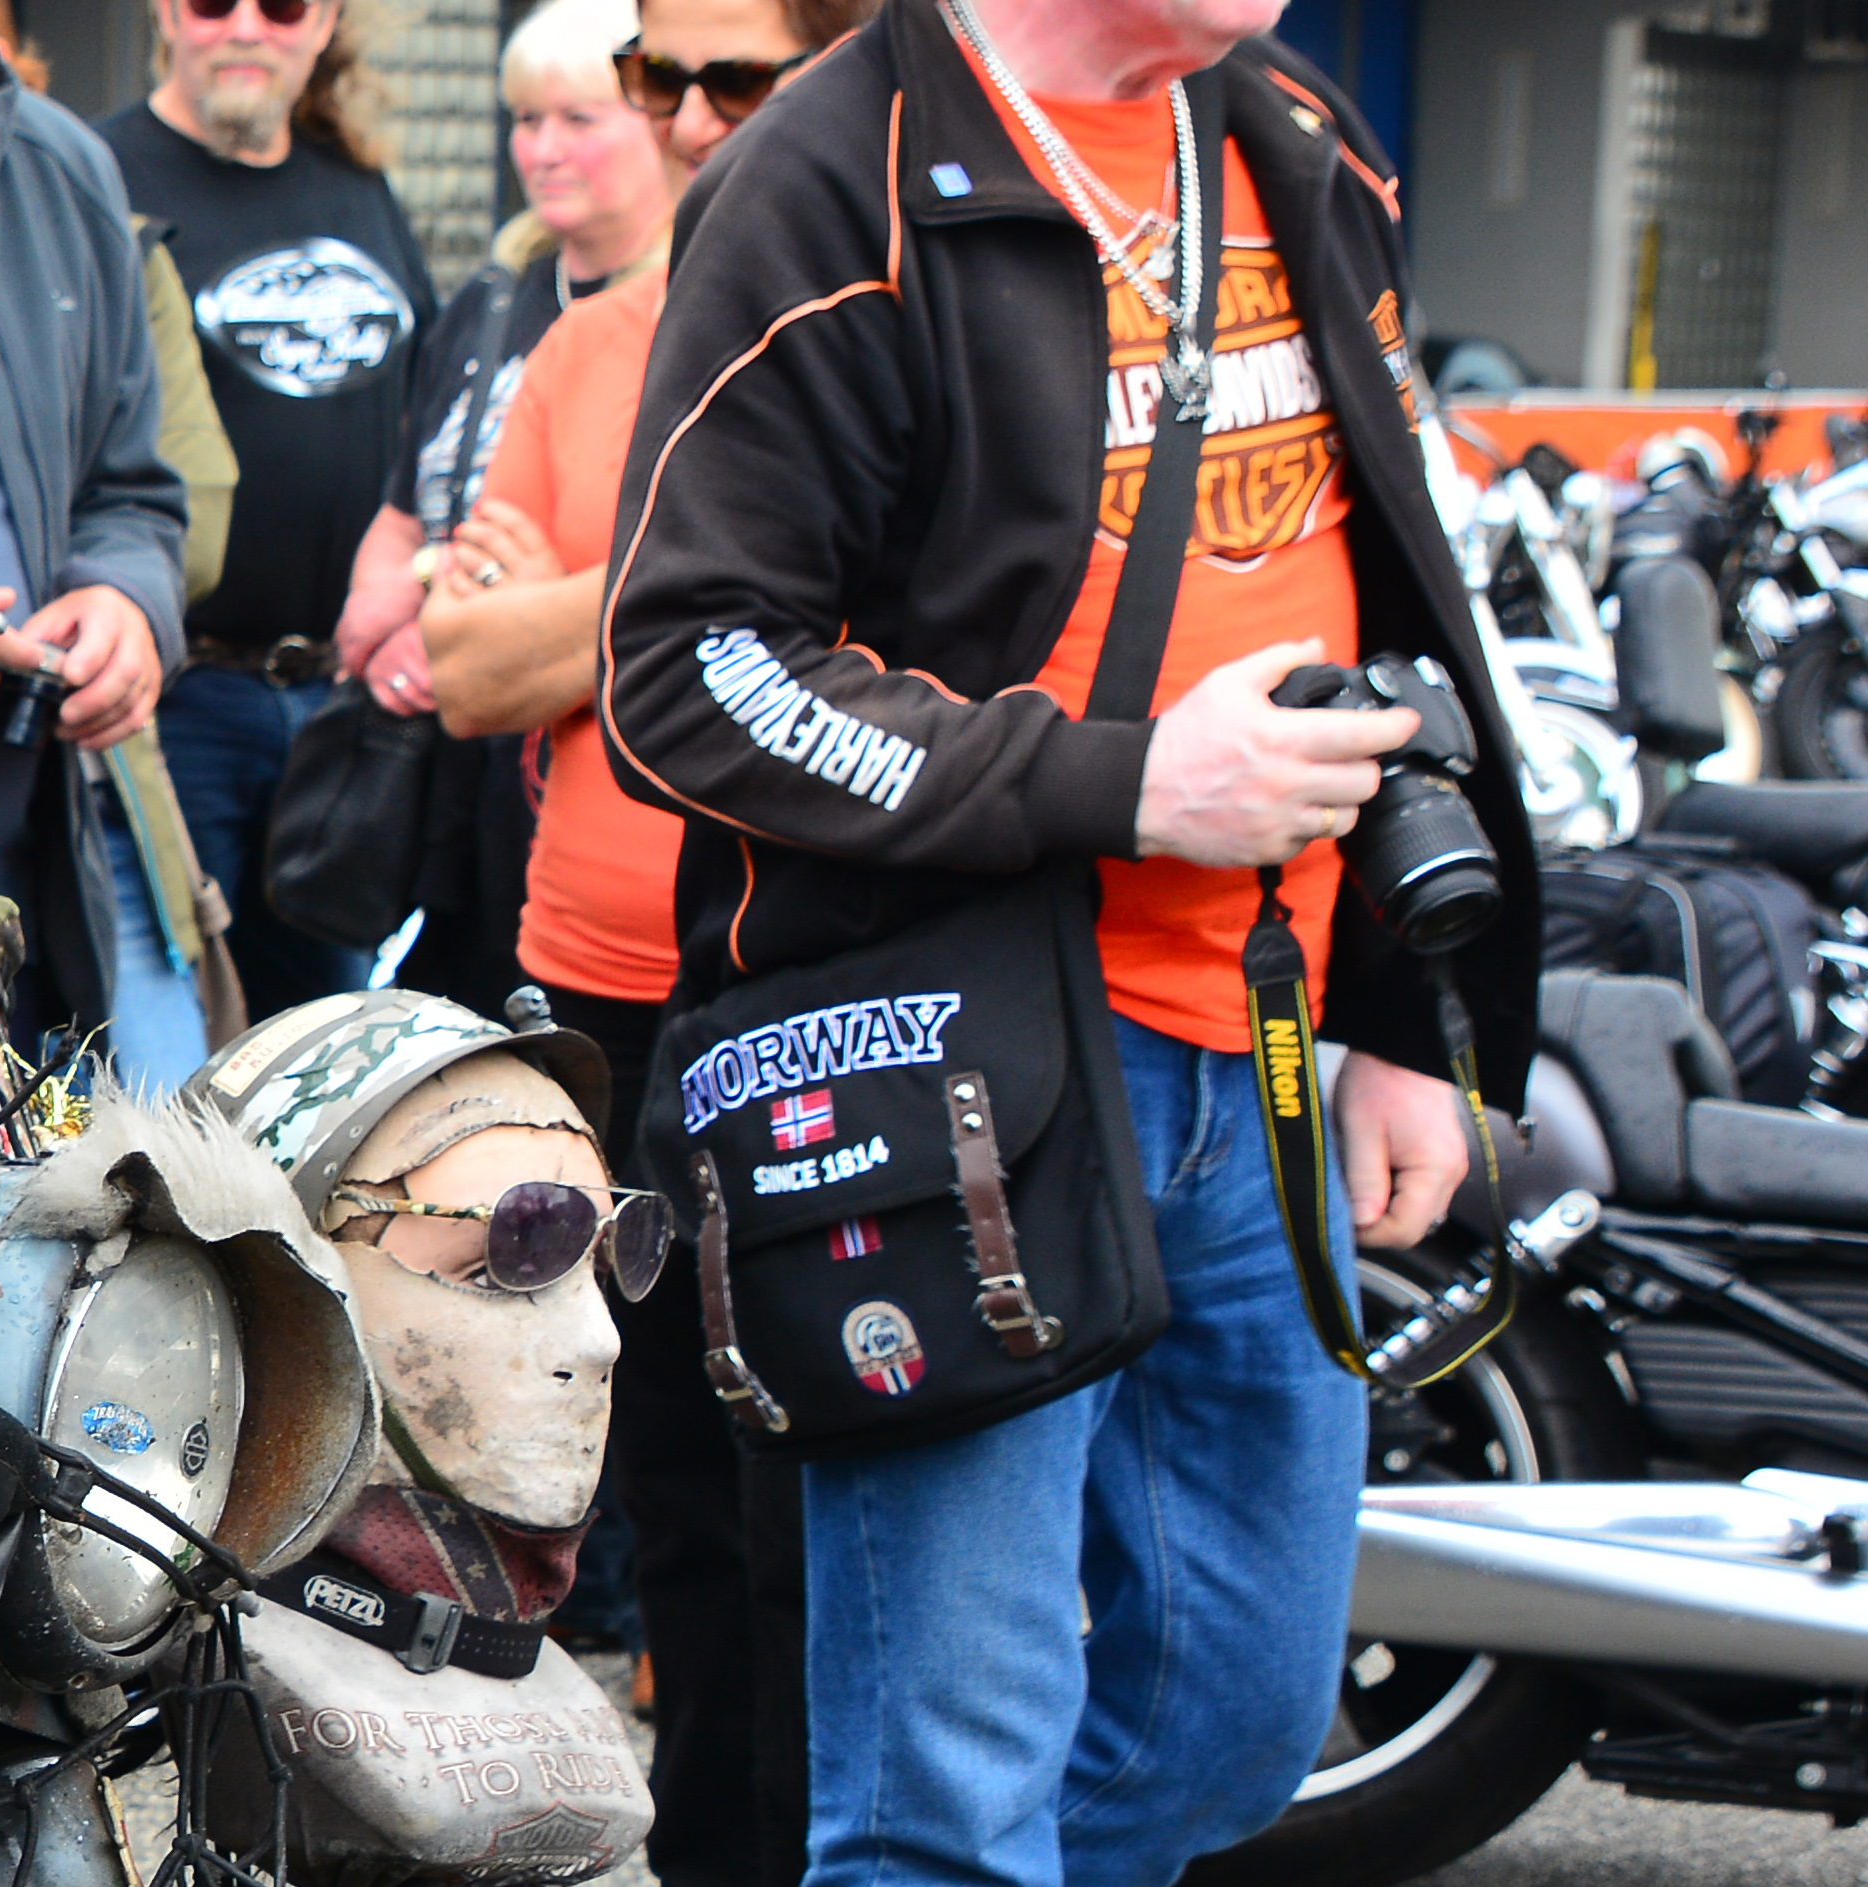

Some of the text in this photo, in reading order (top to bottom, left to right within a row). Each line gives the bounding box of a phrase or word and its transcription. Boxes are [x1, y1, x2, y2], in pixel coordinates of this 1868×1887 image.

[681, 992, 962, 1134] NORWAY
[1263, 1017, 1302, 1119] Nikon
[752, 1135, 891, 1195] SINCE 1814
[304, 1577, 386, 1628] PETZL
[278, 1706, 408, 1756] FOR
[403, 1709, 568, 1752] THOSE
[438, 1750, 633, 1806] TO RIDE
